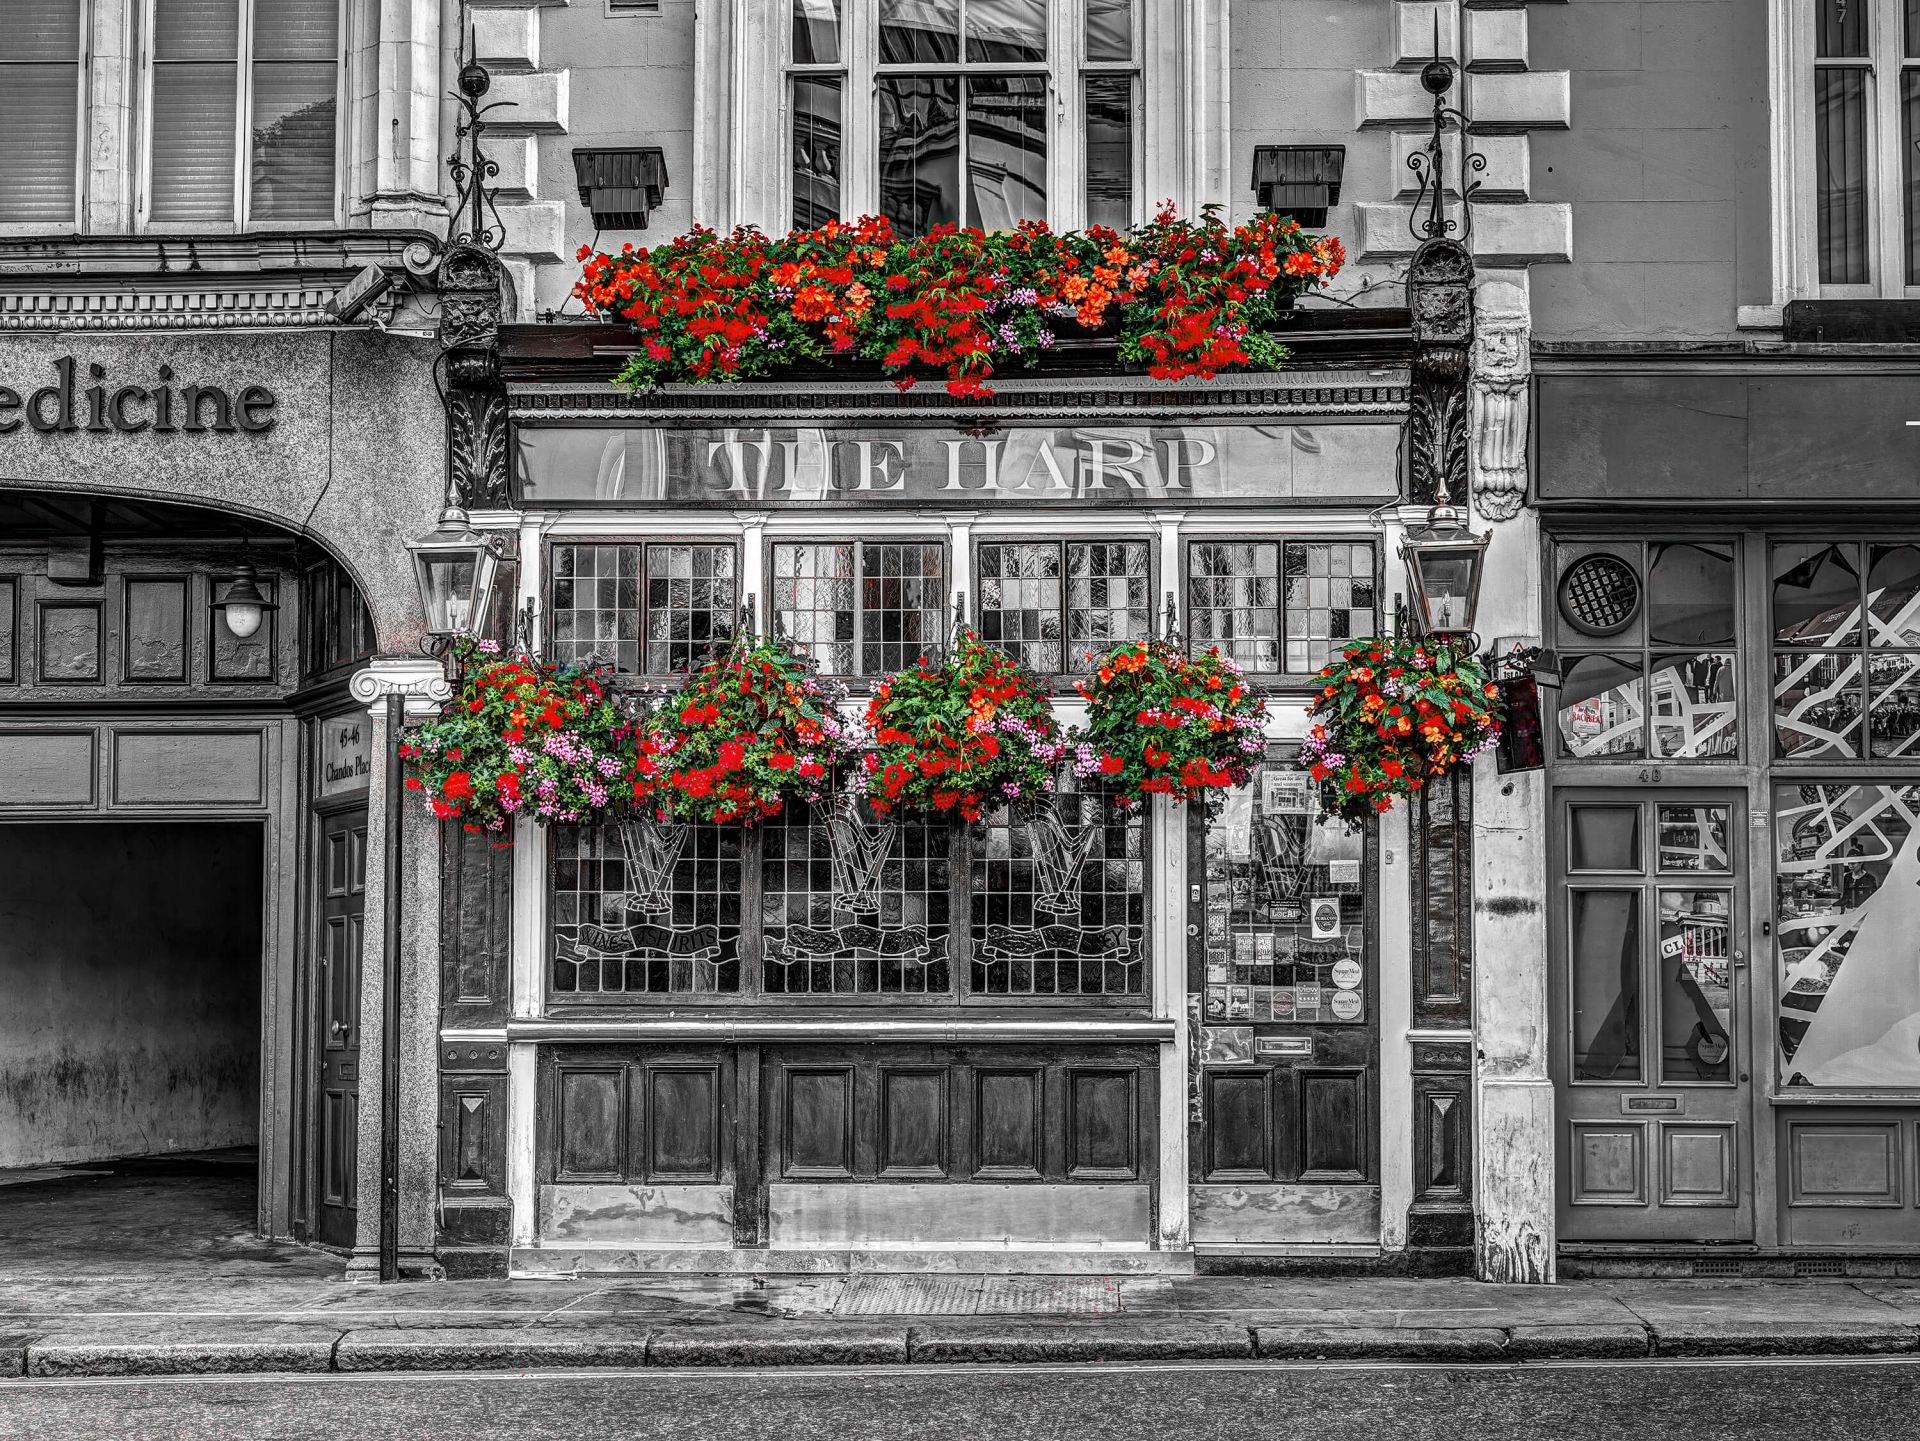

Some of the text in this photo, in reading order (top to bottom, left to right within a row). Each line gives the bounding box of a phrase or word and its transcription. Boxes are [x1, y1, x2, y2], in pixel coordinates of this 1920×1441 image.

[708, 439, 1216, 491] THE HARP
[340, 724, 360, 750] 45-46
[326, 758, 353, 782] Chandos
[1639, 769, 1662, 783] 48
[579, 929, 632, 951] WINES
